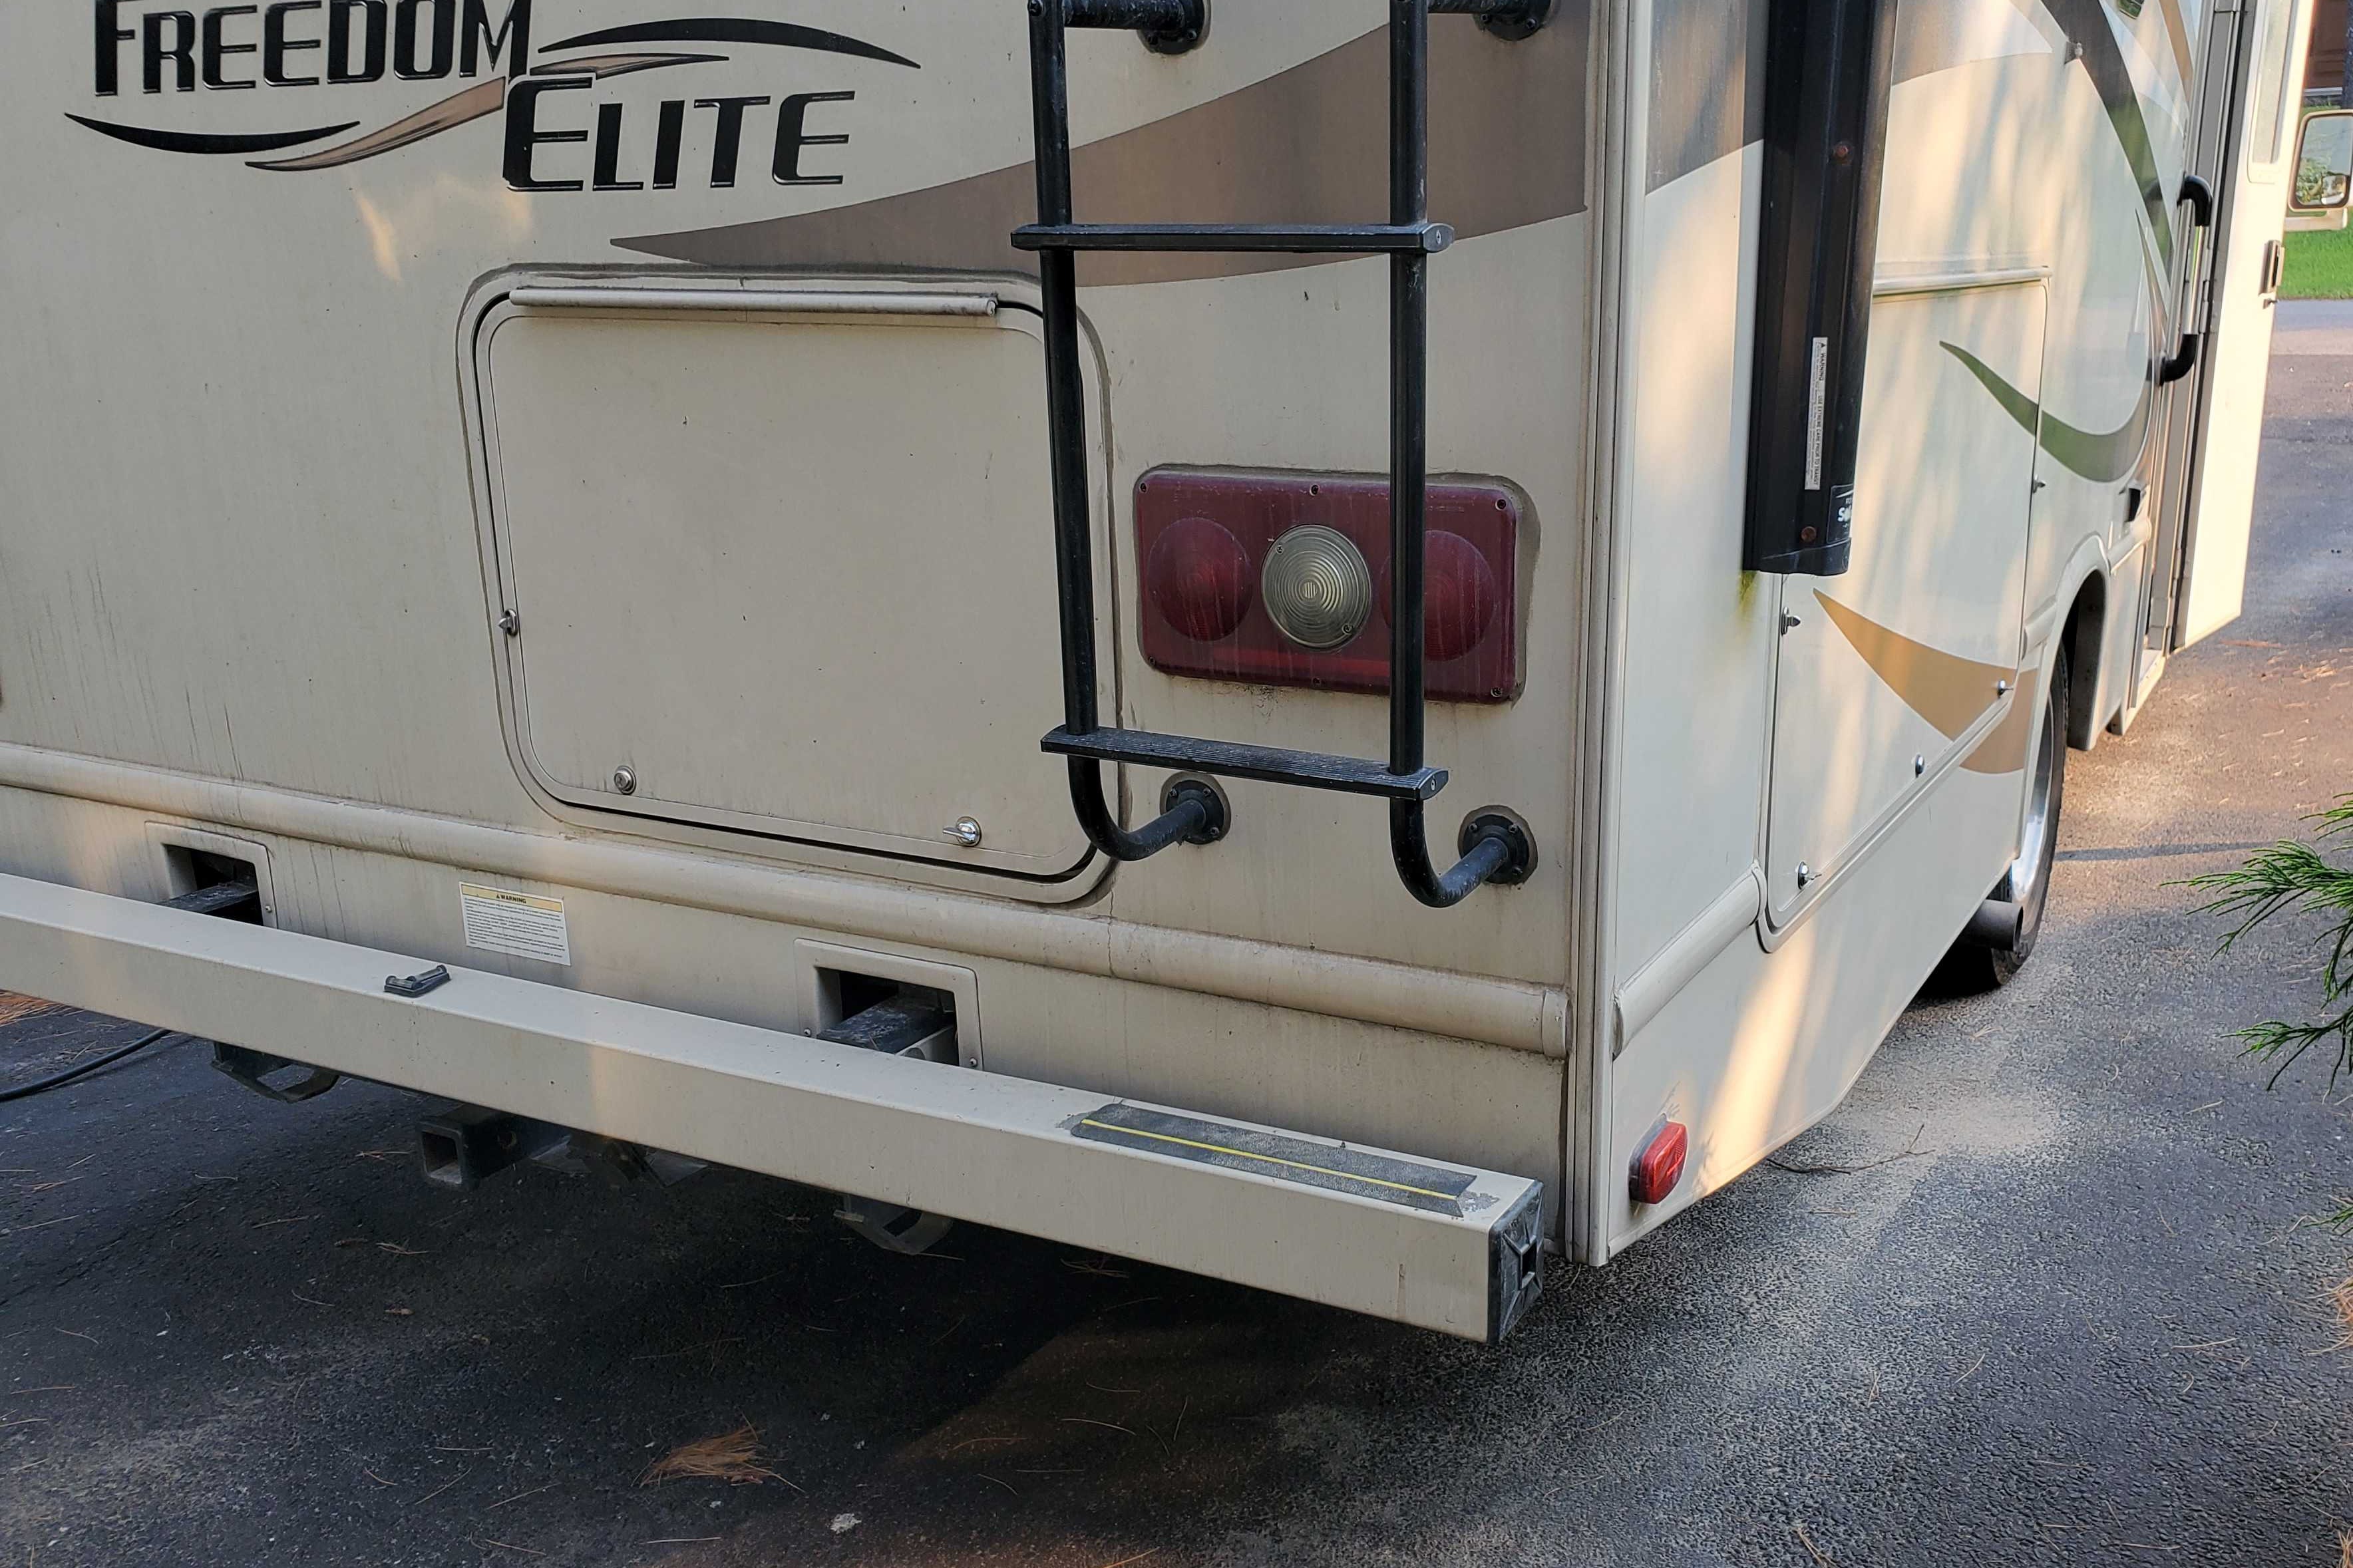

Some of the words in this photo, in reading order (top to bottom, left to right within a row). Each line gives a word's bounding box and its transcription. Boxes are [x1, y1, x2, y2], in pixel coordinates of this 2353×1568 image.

[94, 0, 532, 97] FREEDOM
[502, 76, 855, 192] ELITE
[501, 894, 526, 903] WARNING
